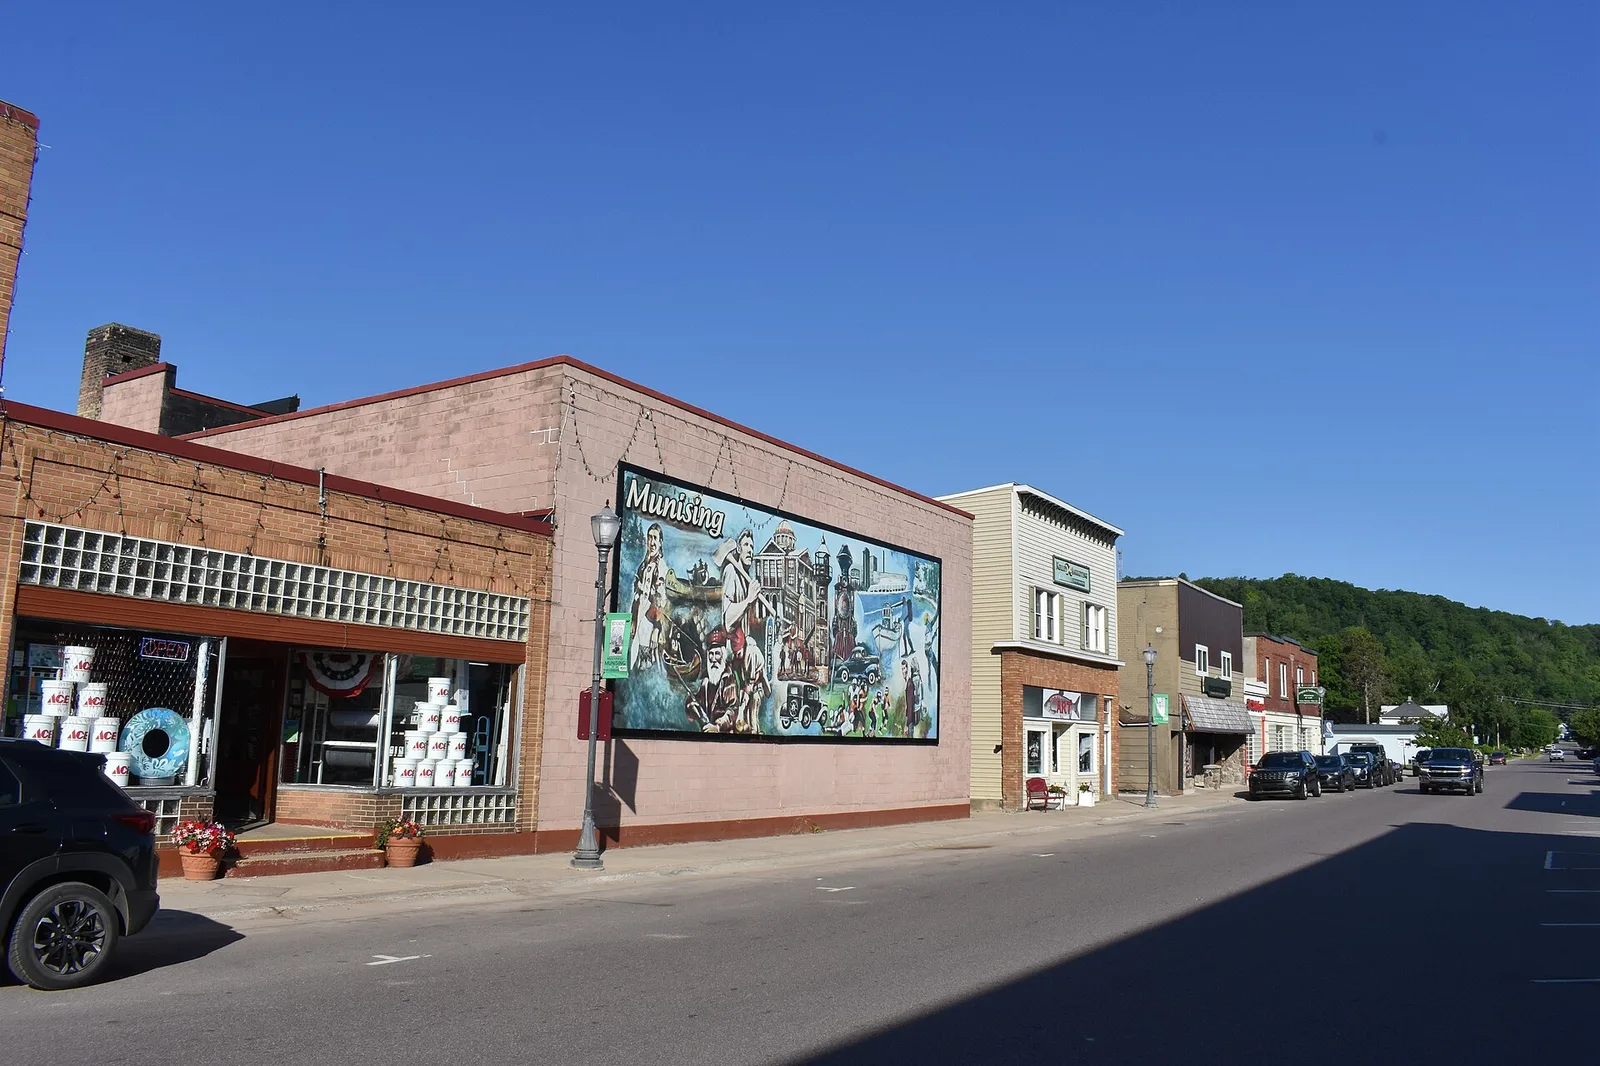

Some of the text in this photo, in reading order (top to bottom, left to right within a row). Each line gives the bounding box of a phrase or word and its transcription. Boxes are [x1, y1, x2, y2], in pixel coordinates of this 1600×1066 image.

[625, 478, 725, 539] Munising
[143, 640, 187, 659] OPEN
[74, 660, 92, 671] AC
[437, 688, 449, 696] AC
[47, 693, 70, 704] ACE
[84, 695, 105, 706] ACE
[1056, 700, 1073, 715] ART
[427, 714, 439, 722] AC
[67, 729, 88, 740] ACE
[95, 729, 117, 740] ACE
[461, 769, 472, 777] AC
